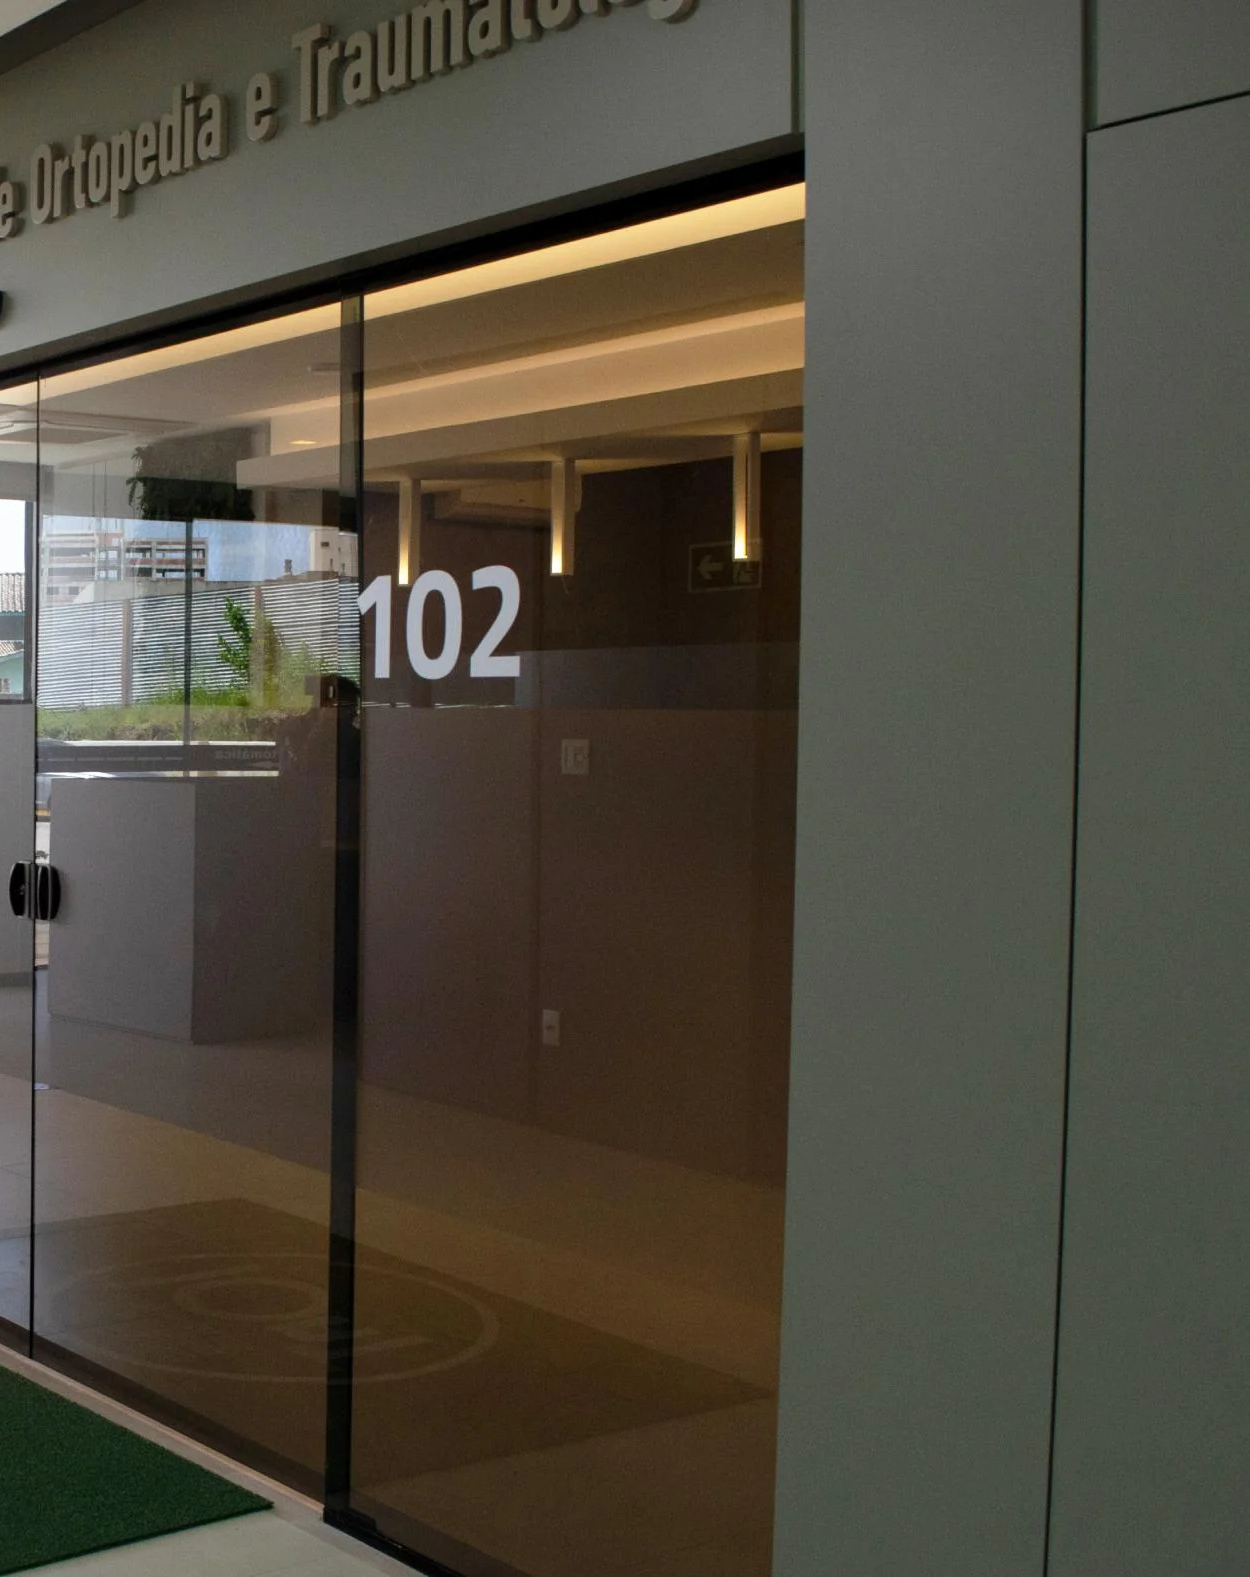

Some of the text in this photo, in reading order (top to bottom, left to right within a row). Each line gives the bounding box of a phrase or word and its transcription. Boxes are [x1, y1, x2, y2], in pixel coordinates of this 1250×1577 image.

[30, 81, 223, 224] Ortopedia
[246, 73, 275, 141] e
[292, 0, 696, 122] Trauma
[357, 565, 521, 680] 102
